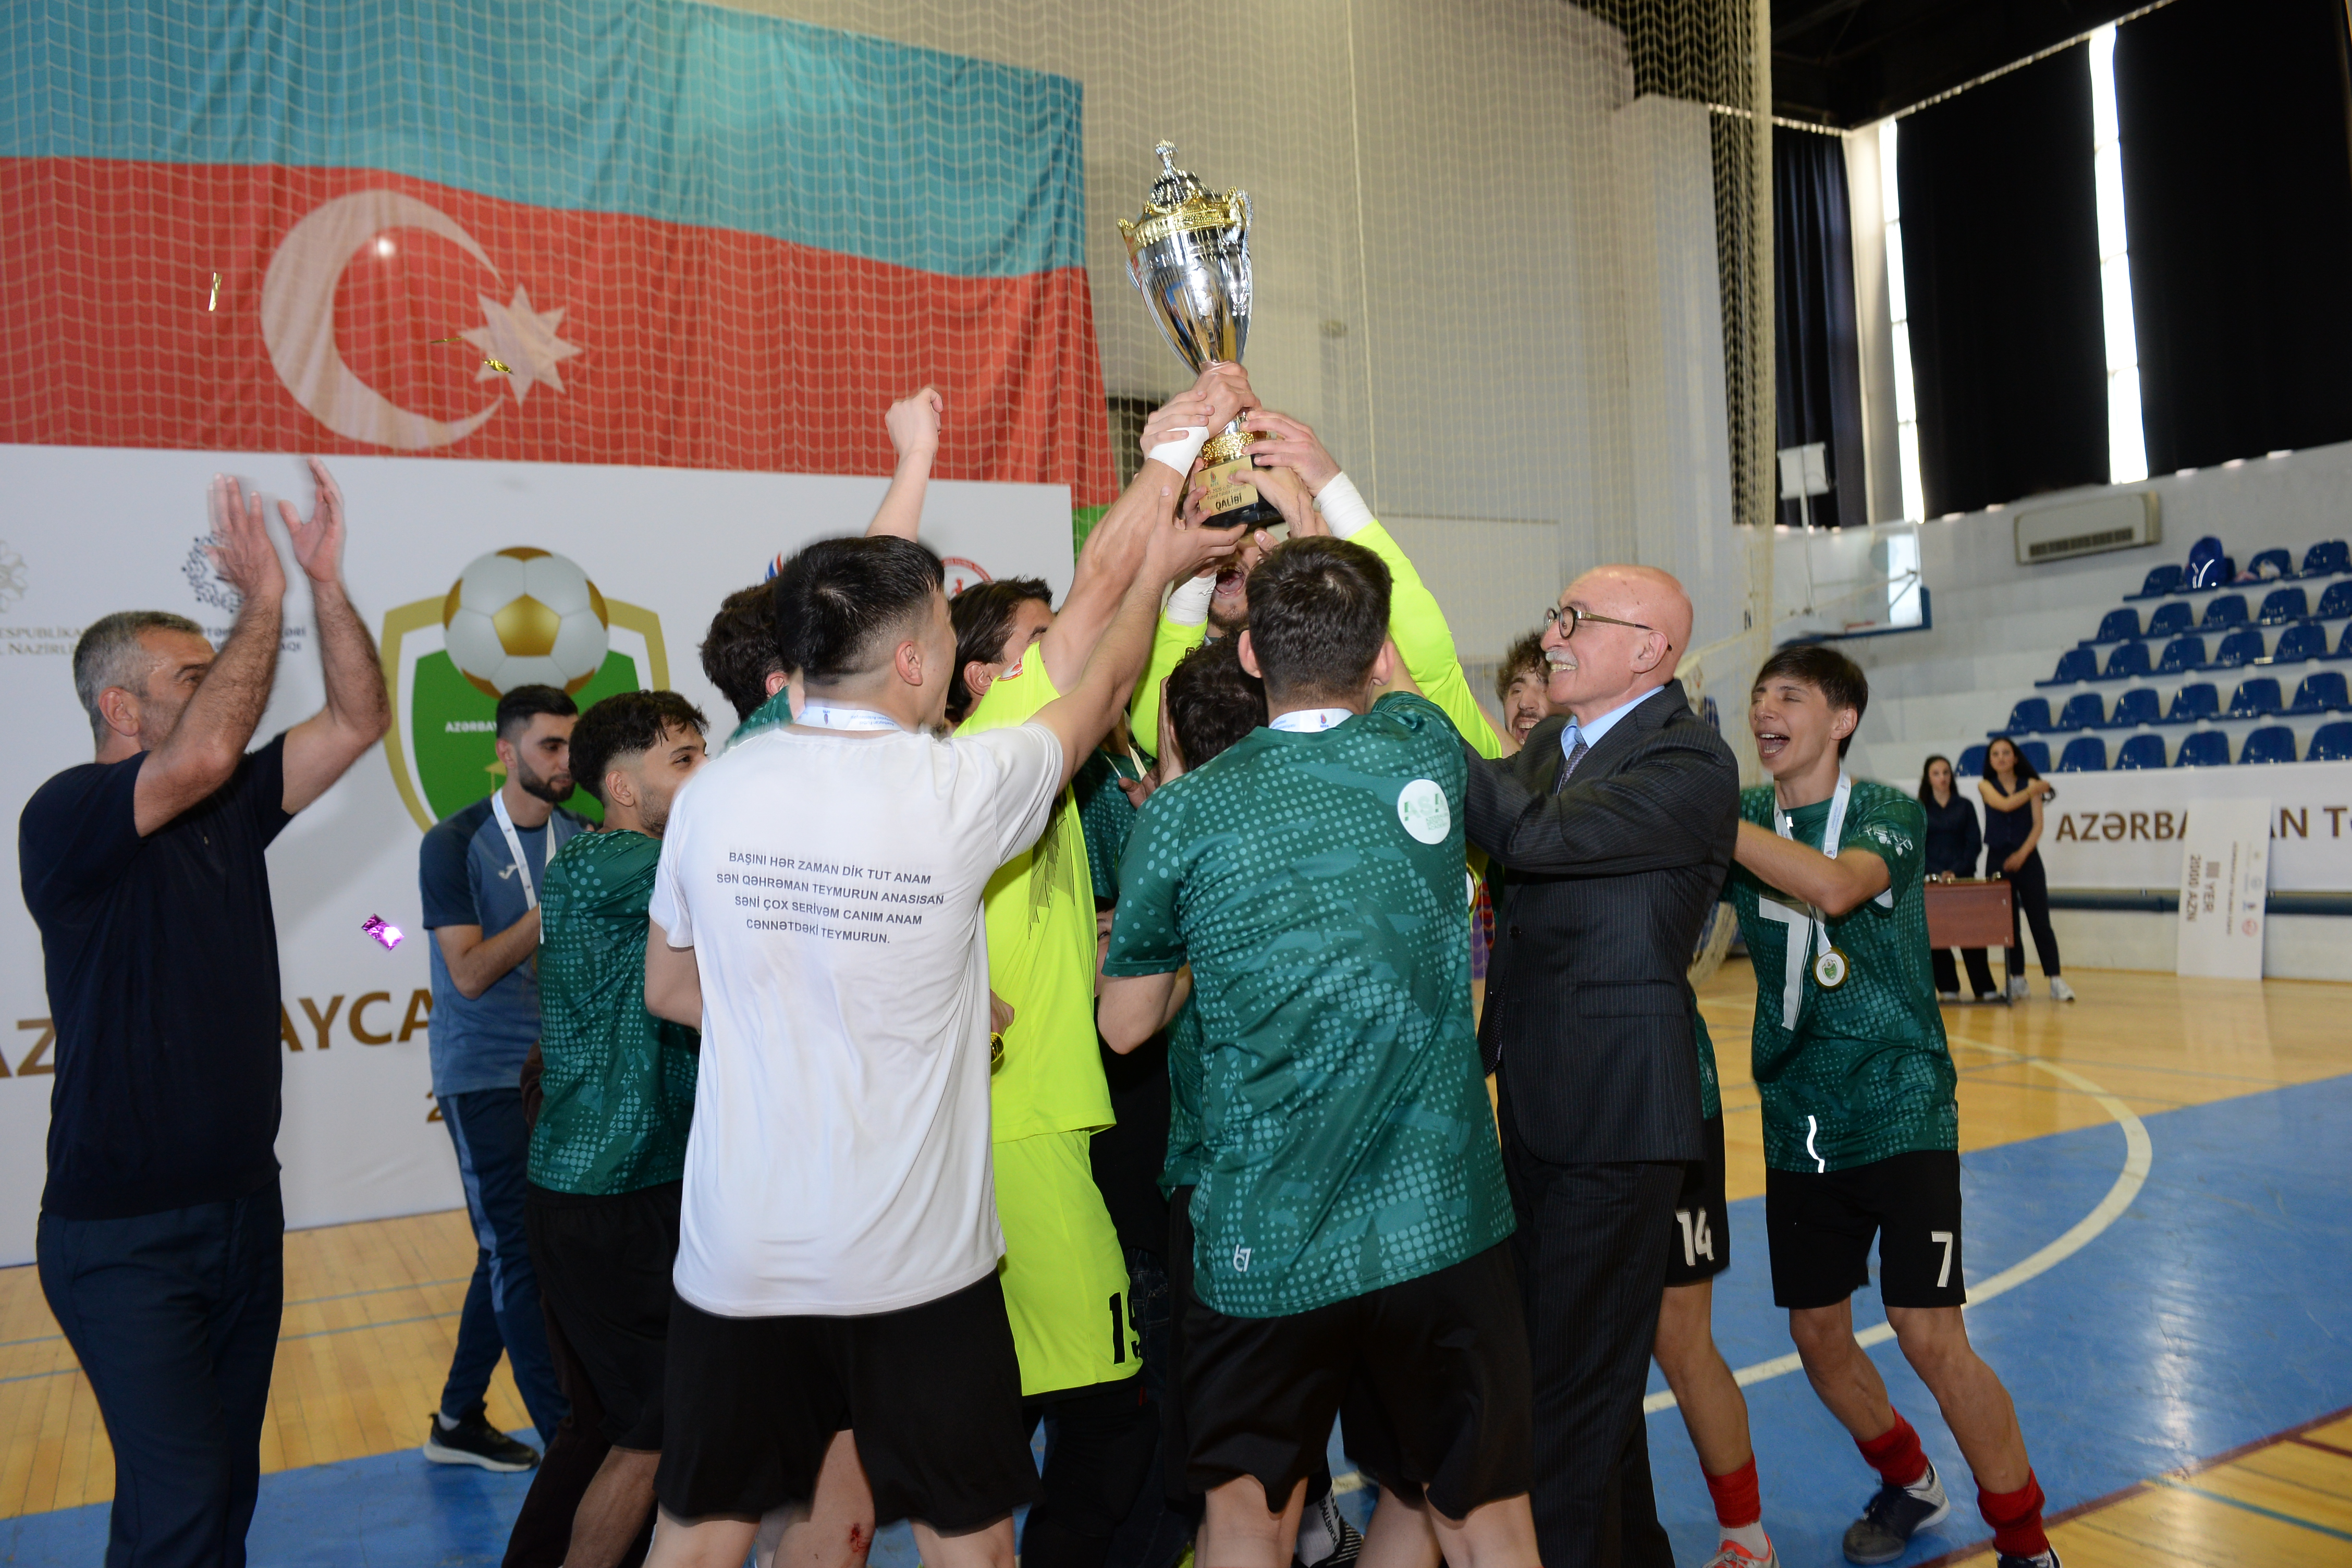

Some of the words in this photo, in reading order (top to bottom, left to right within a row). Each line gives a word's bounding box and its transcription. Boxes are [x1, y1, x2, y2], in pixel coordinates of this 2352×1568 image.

[1215, 493, 1242, 511] QALİBİ
[2055, 806, 2309, 842] AZƏRBN
[2323, 805, 2352, 838] T
[729, 852, 767, 866] BAŞINI
[770, 856, 795, 869] HƏR
[798, 860, 839, 875] ZAMAN
[842, 864, 864, 878] DİK
[867, 869, 892, 881] TUT
[893, 873, 932, 885] ANAM
[717, 873, 739, 884] SƏN
[742, 875, 809, 892] QƏHRƏMAN
[812, 884, 878, 901] TEYMURUN
[880, 892, 945, 905] ANASISAN
[735, 896, 760, 908] SƏNİ
[763, 899, 789, 911] ÇOX
[792, 901, 840, 918] SERİVƏM
[843, 910, 884, 922] CANIM
[885, 913, 922, 925] ANAM
[746, 918, 818, 936] CƏNNƏTDƏKİ
[821, 927, 890, 944] TEYMURUN.
[1676, 1208, 1714, 1267] 14
[1931, 1230, 1953, 1288] 7
